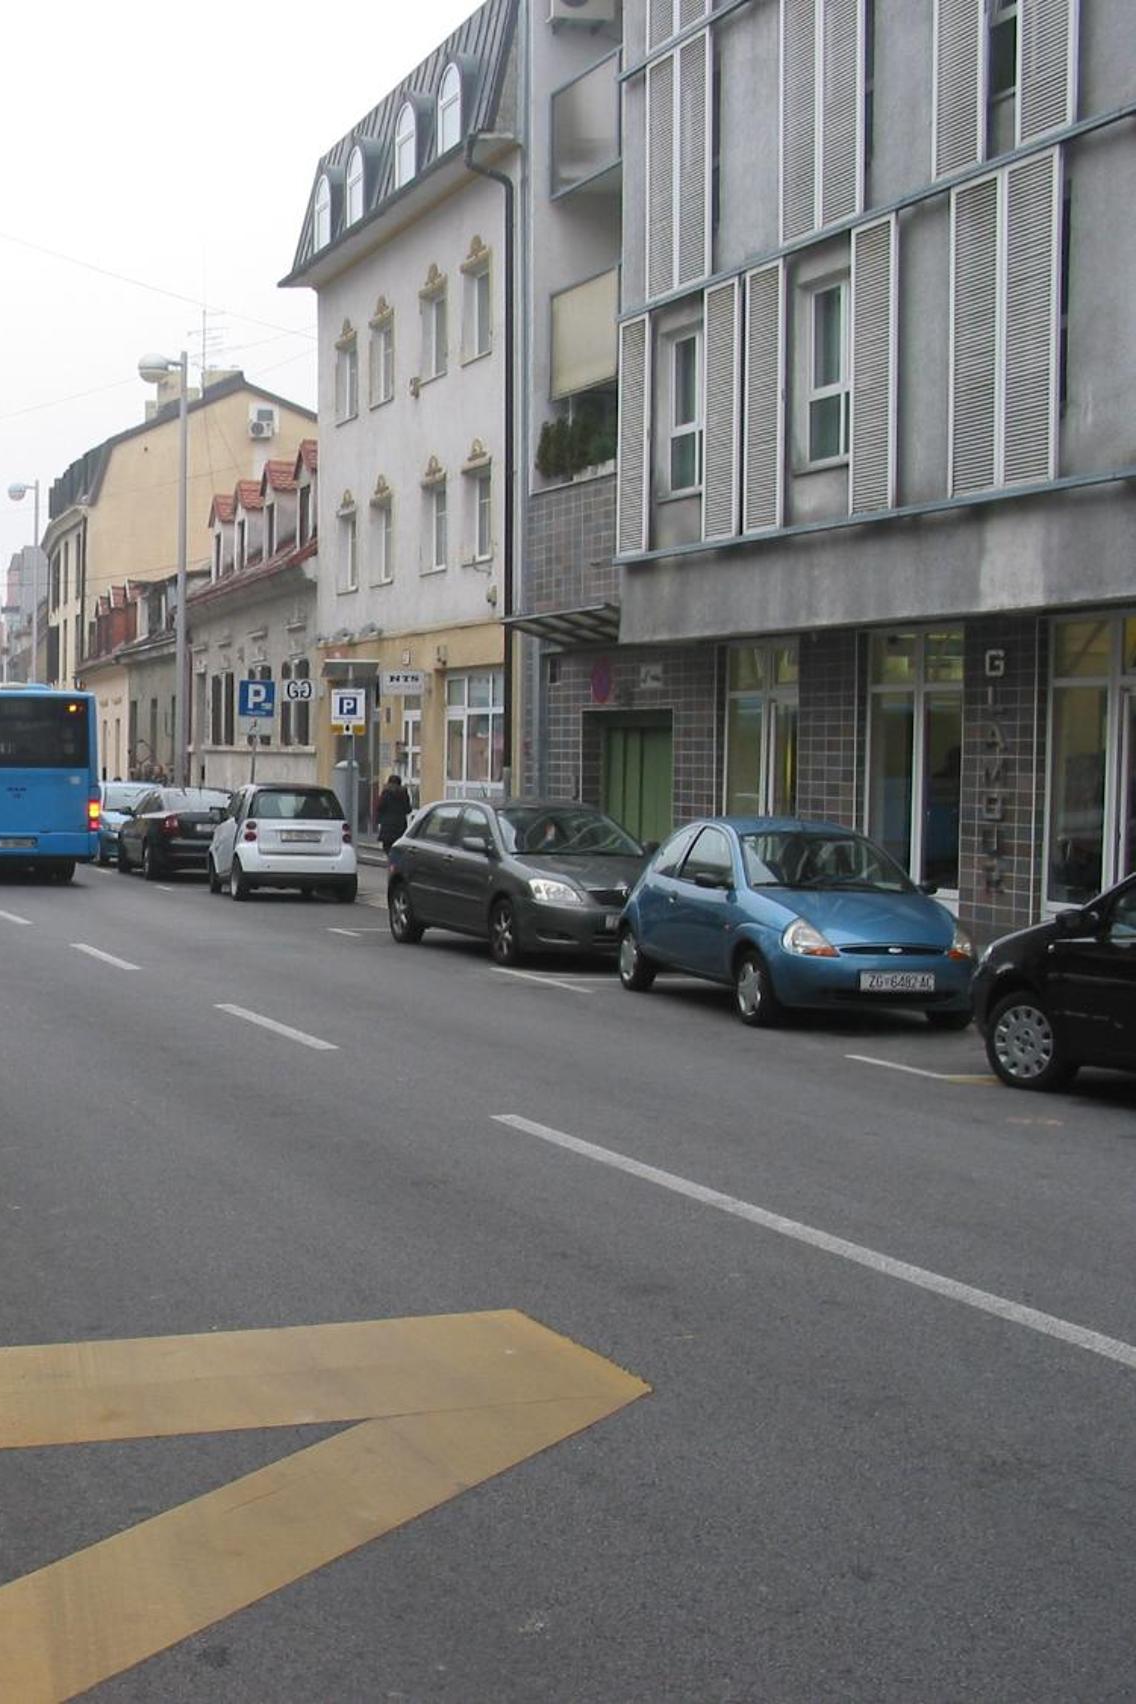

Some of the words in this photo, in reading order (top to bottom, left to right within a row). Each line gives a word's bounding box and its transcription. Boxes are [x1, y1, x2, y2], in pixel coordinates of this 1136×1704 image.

[247, 683, 267, 709] P
[343, 699, 355, 715] P
[868, 974, 884, 988] ZG
